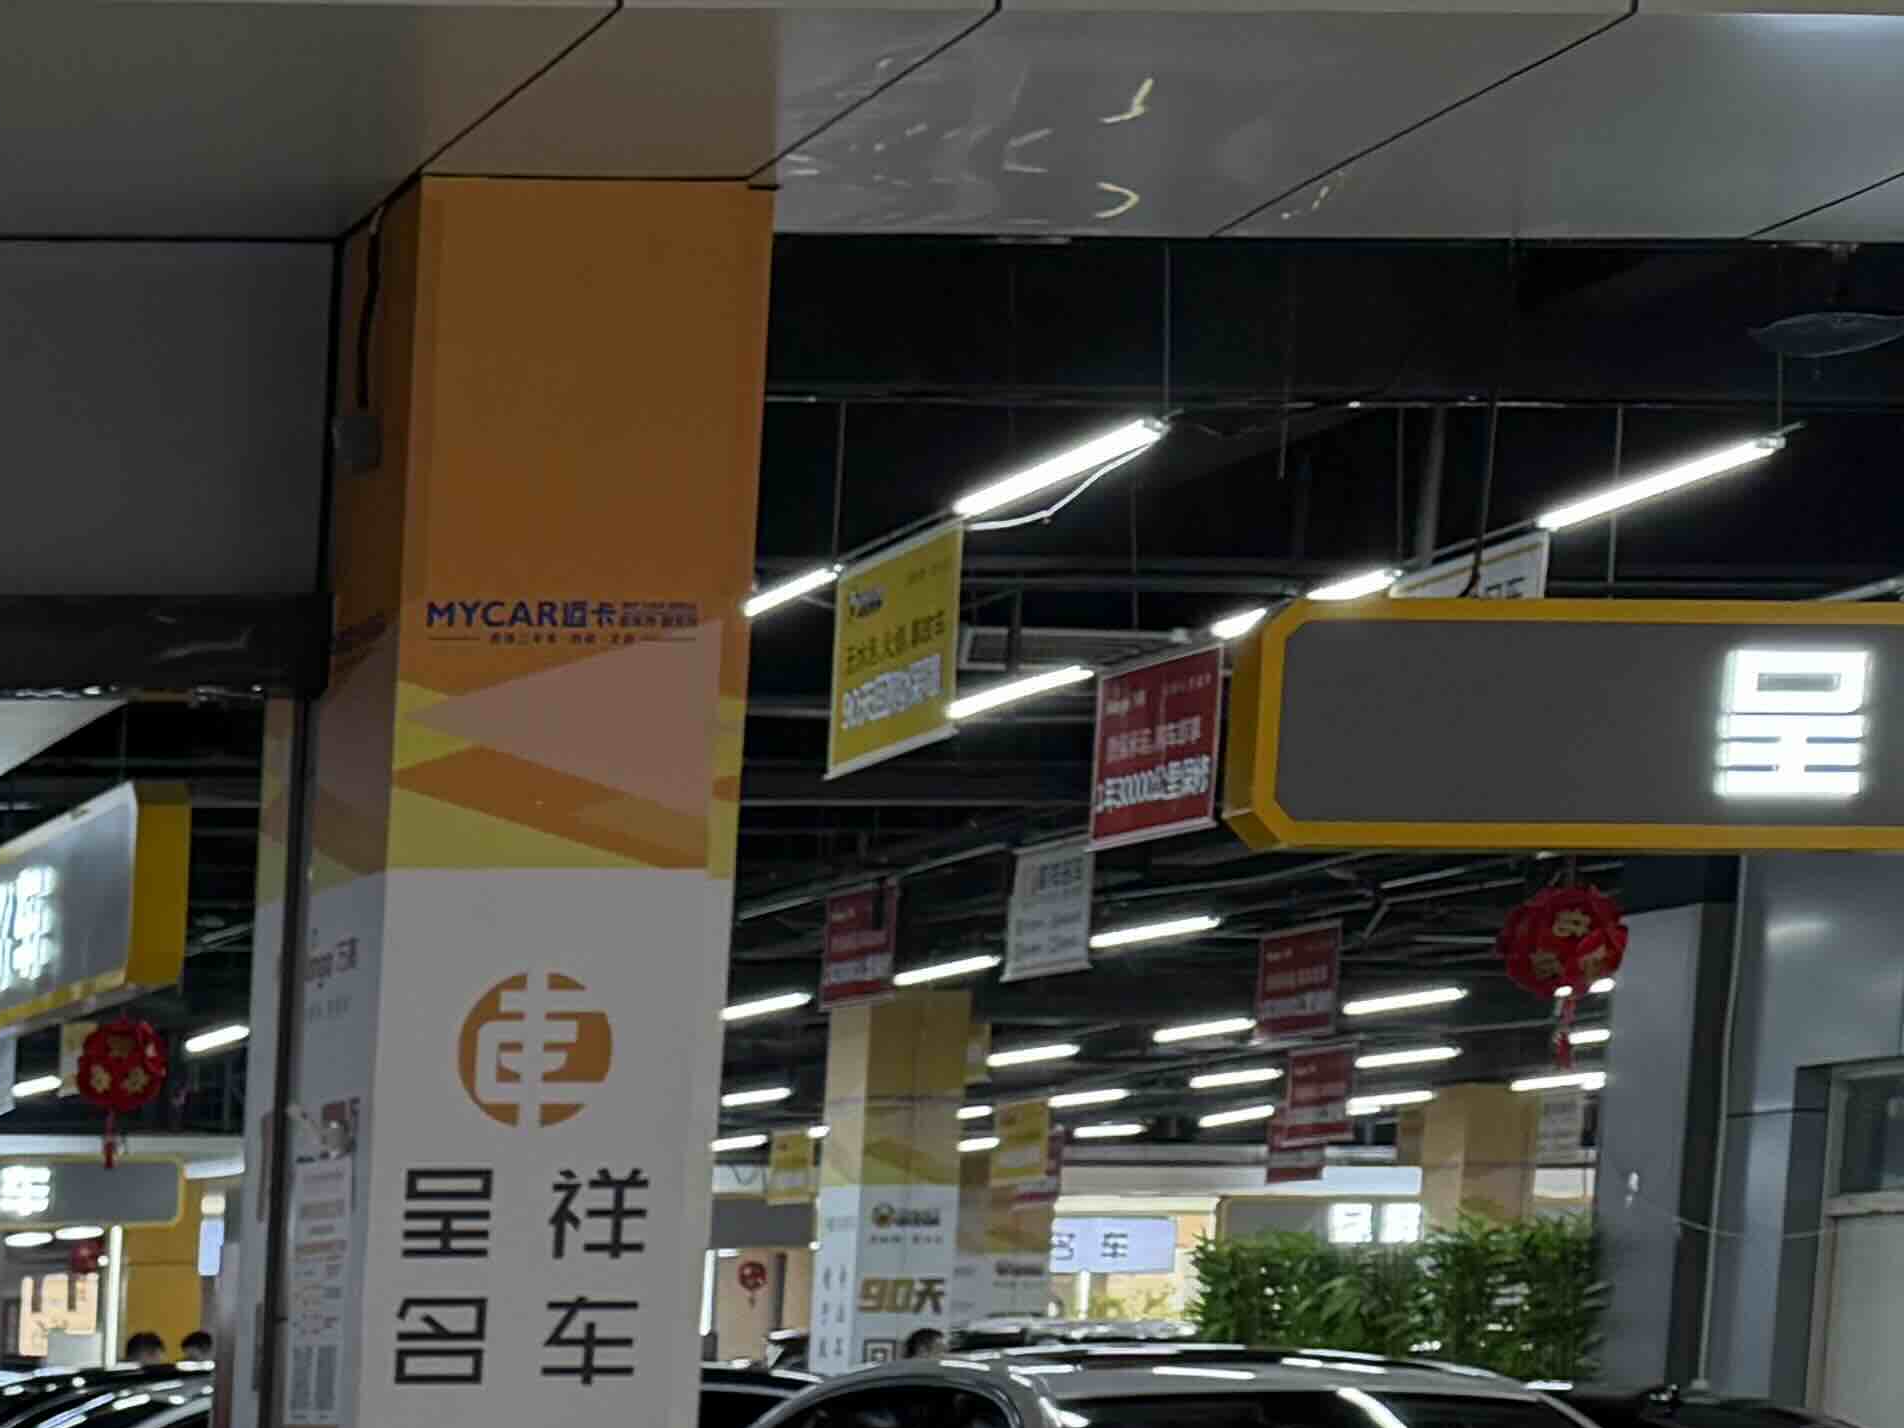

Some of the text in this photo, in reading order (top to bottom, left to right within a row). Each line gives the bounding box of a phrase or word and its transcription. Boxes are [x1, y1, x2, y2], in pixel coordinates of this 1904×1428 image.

[1715, 649, 1870, 798] 呈
[402, 1168, 649, 1260] 呈祥
[393, 1296, 639, 1386] 名车
[858, 1277, 946, 1315] 90天
